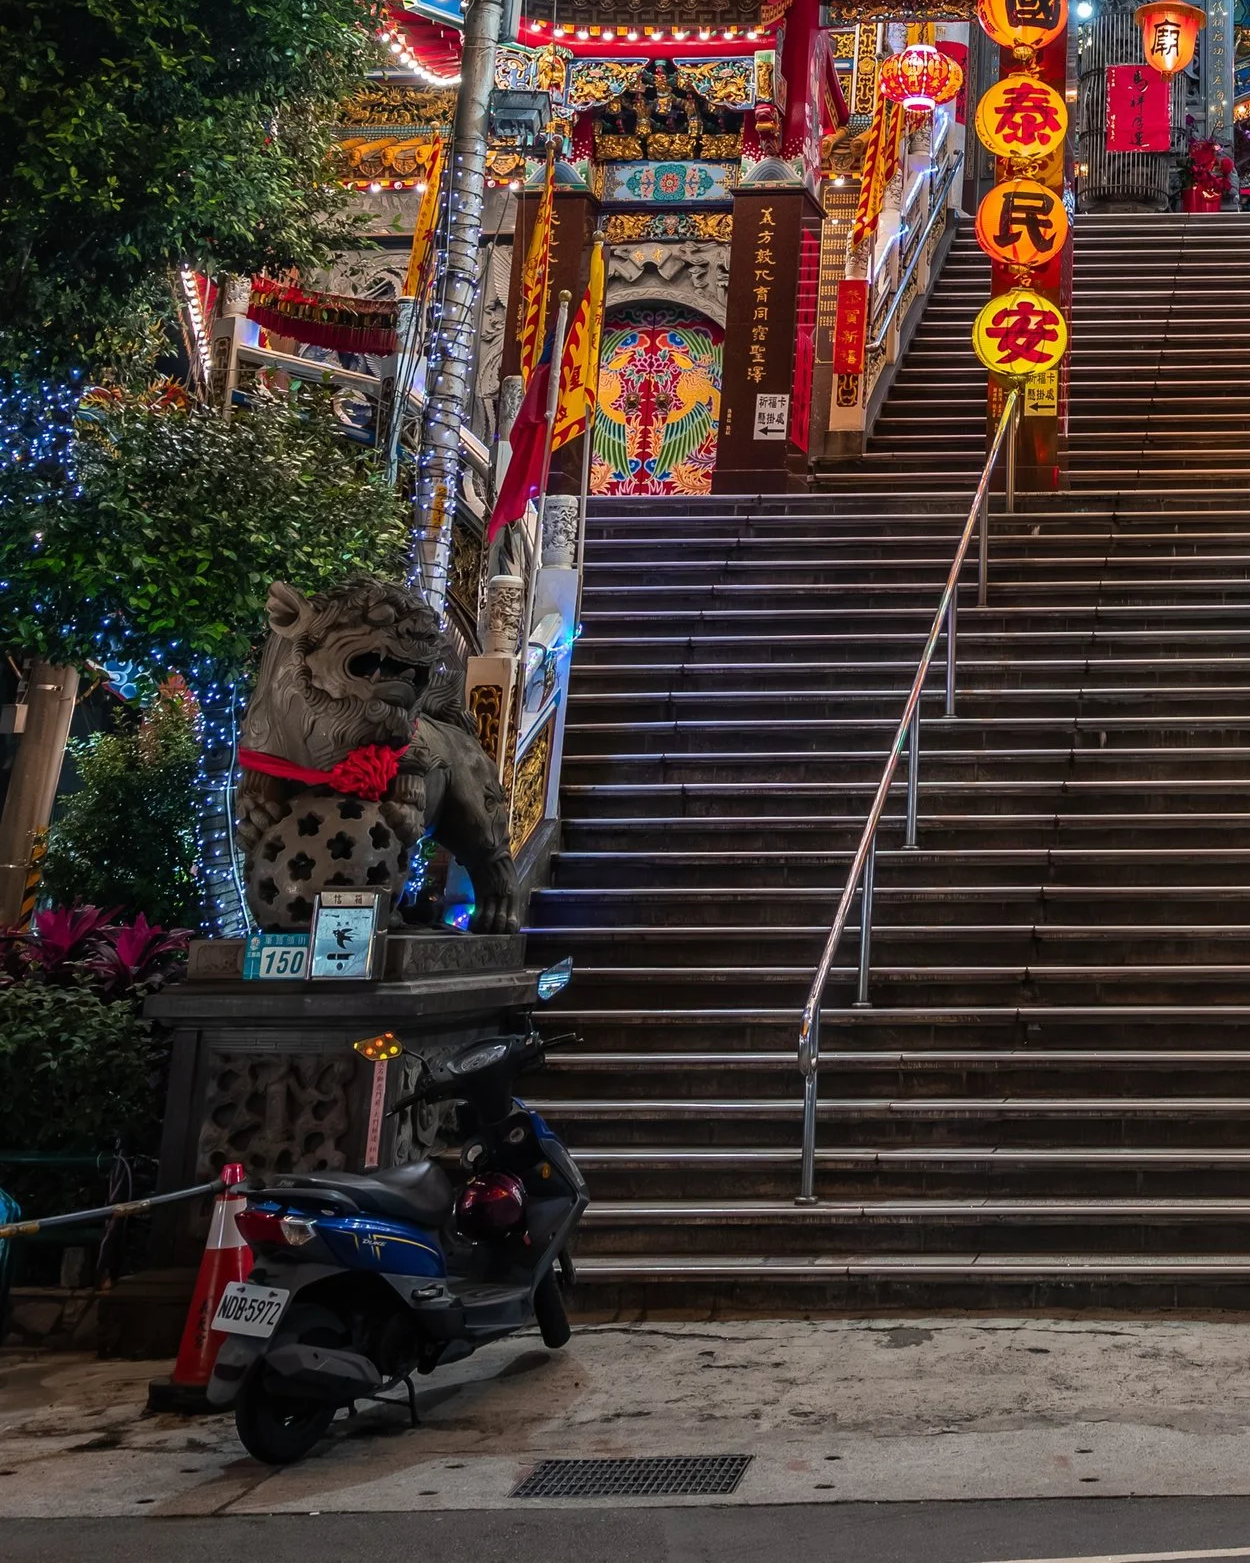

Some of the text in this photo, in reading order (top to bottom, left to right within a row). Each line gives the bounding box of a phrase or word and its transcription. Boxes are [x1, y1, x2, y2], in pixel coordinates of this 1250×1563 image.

[1150, 18, 1182, 58] 廟
[839, 289, 861, 365] 恭賀新禧
[758, 395, 787, 408] 祈福卡
[1027, 388, 1055, 401] 懸掛處
[757, 411, 785, 426] 懸掛處
[334, 893, 364, 905] 信箱
[265, 950, 305, 975] 150
